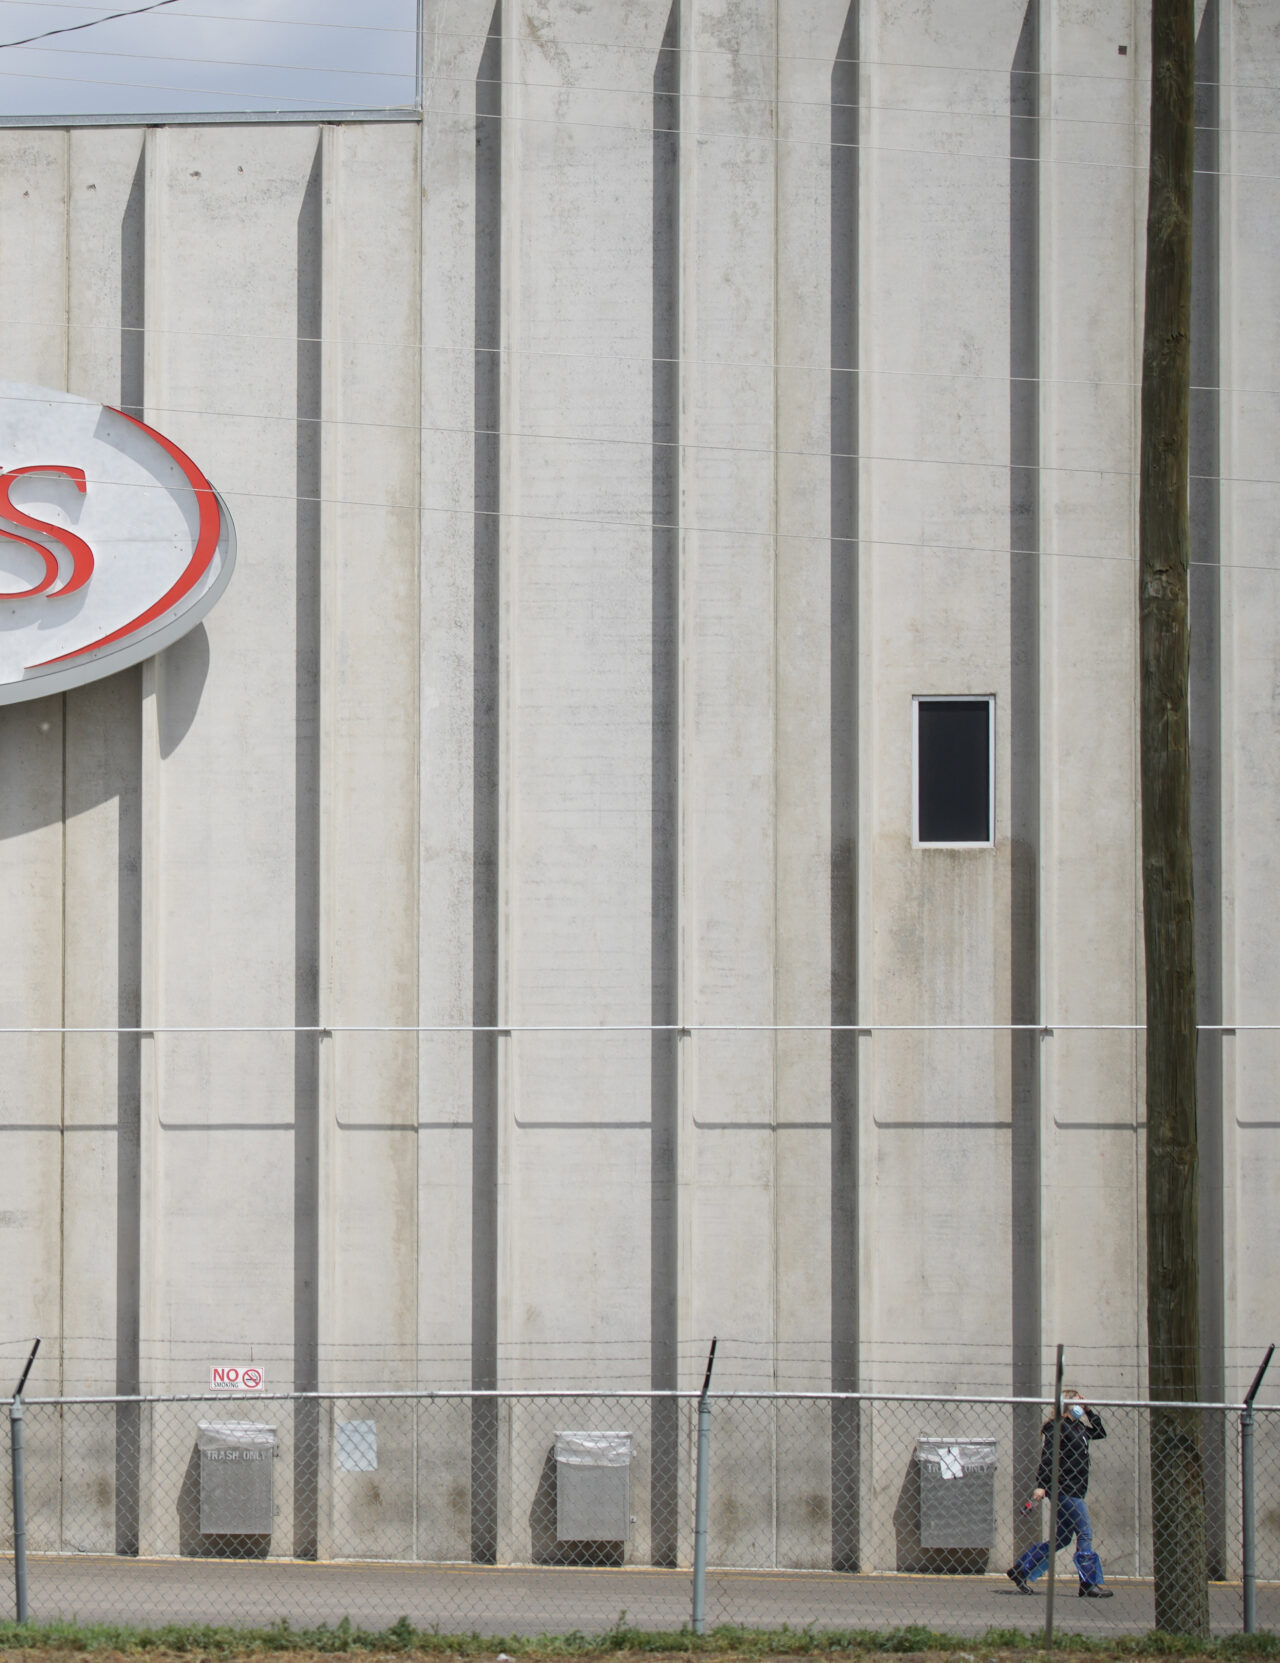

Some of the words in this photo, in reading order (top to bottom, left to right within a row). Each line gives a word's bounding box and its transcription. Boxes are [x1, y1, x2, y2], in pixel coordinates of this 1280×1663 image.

[213, 1368, 239, 1382] NO
[207, 1450, 239, 1460] TRASH
[243, 1450, 266, 1460] ONLY
